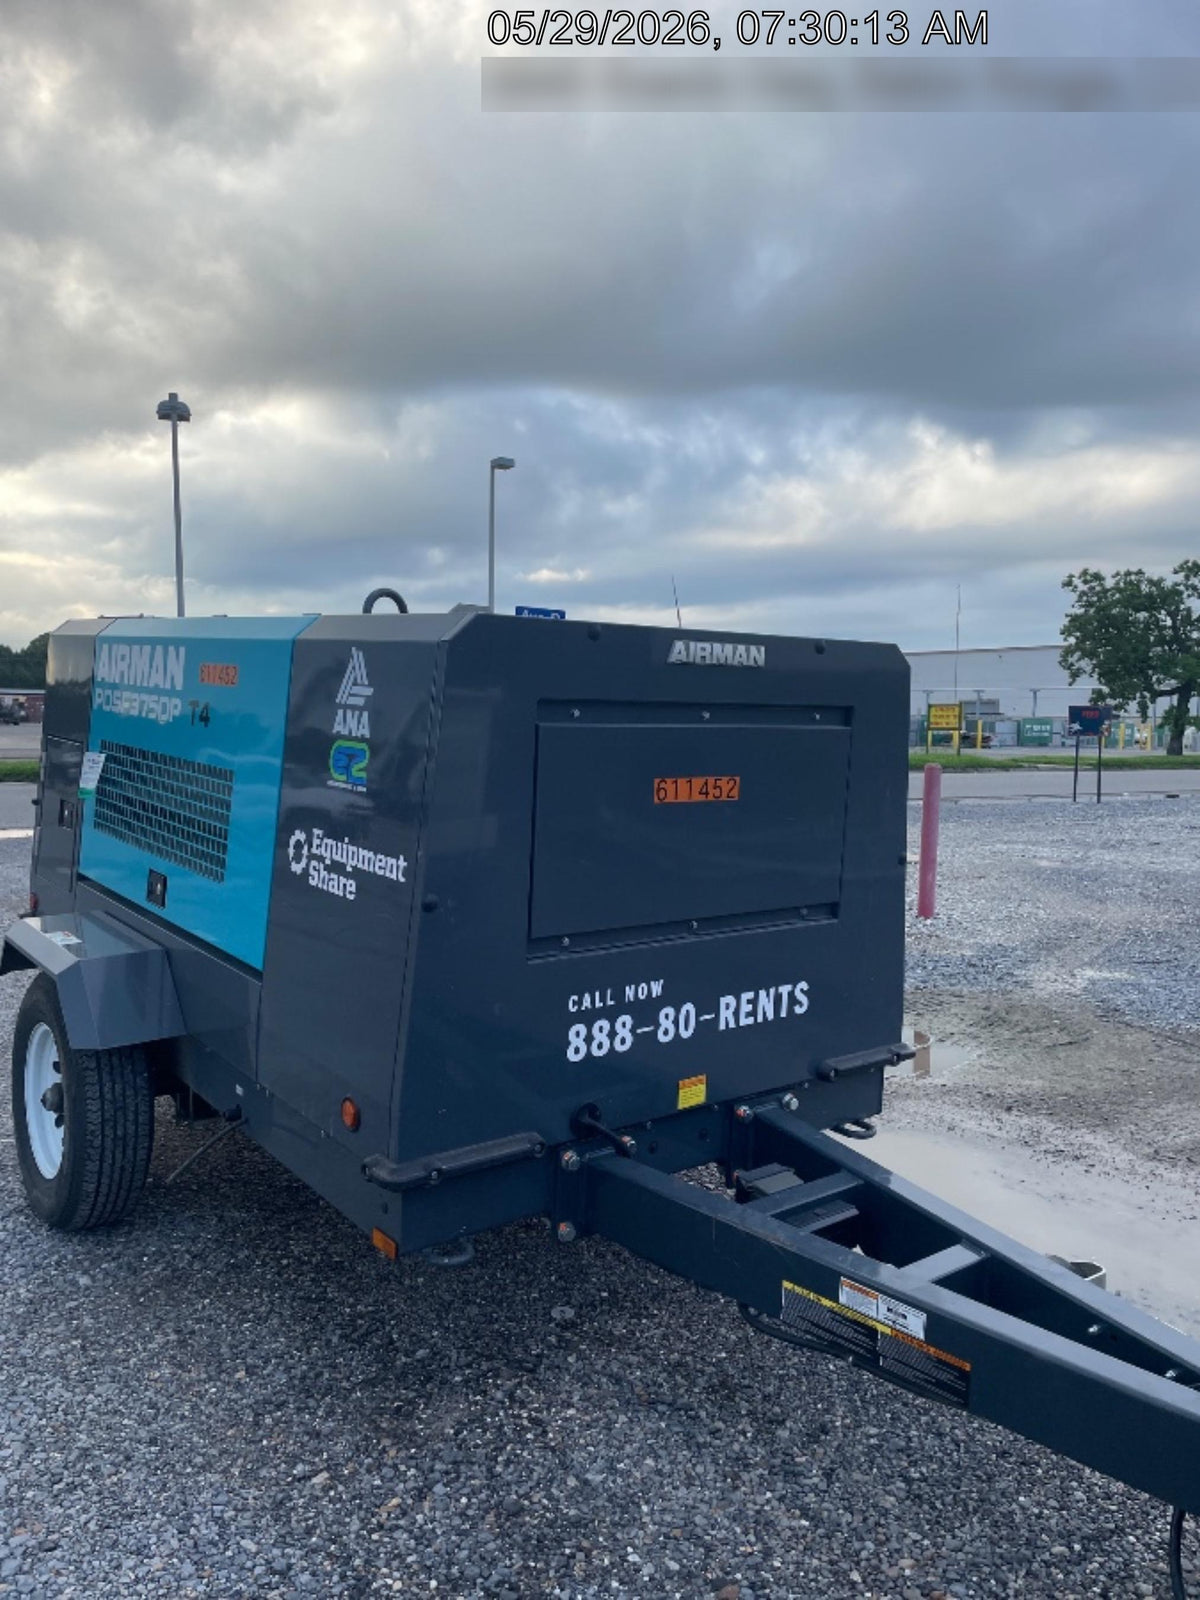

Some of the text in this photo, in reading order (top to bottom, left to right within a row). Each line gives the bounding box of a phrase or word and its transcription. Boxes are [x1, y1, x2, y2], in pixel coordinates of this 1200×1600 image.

[95, 643, 186, 691] AIRMAN
[666, 640, 766, 668] AIRMAN
[200, 663, 238, 686] 611452
[187, 699, 211, 728] T4
[332, 708, 371, 739] ANA
[656, 778, 737, 801] 611452
[310, 828, 408, 883] Equipment
[308, 858, 357, 900] Share
[568, 979, 665, 1013] CALL NOW
[566, 980, 810, 1063] 888-80-RENTS
